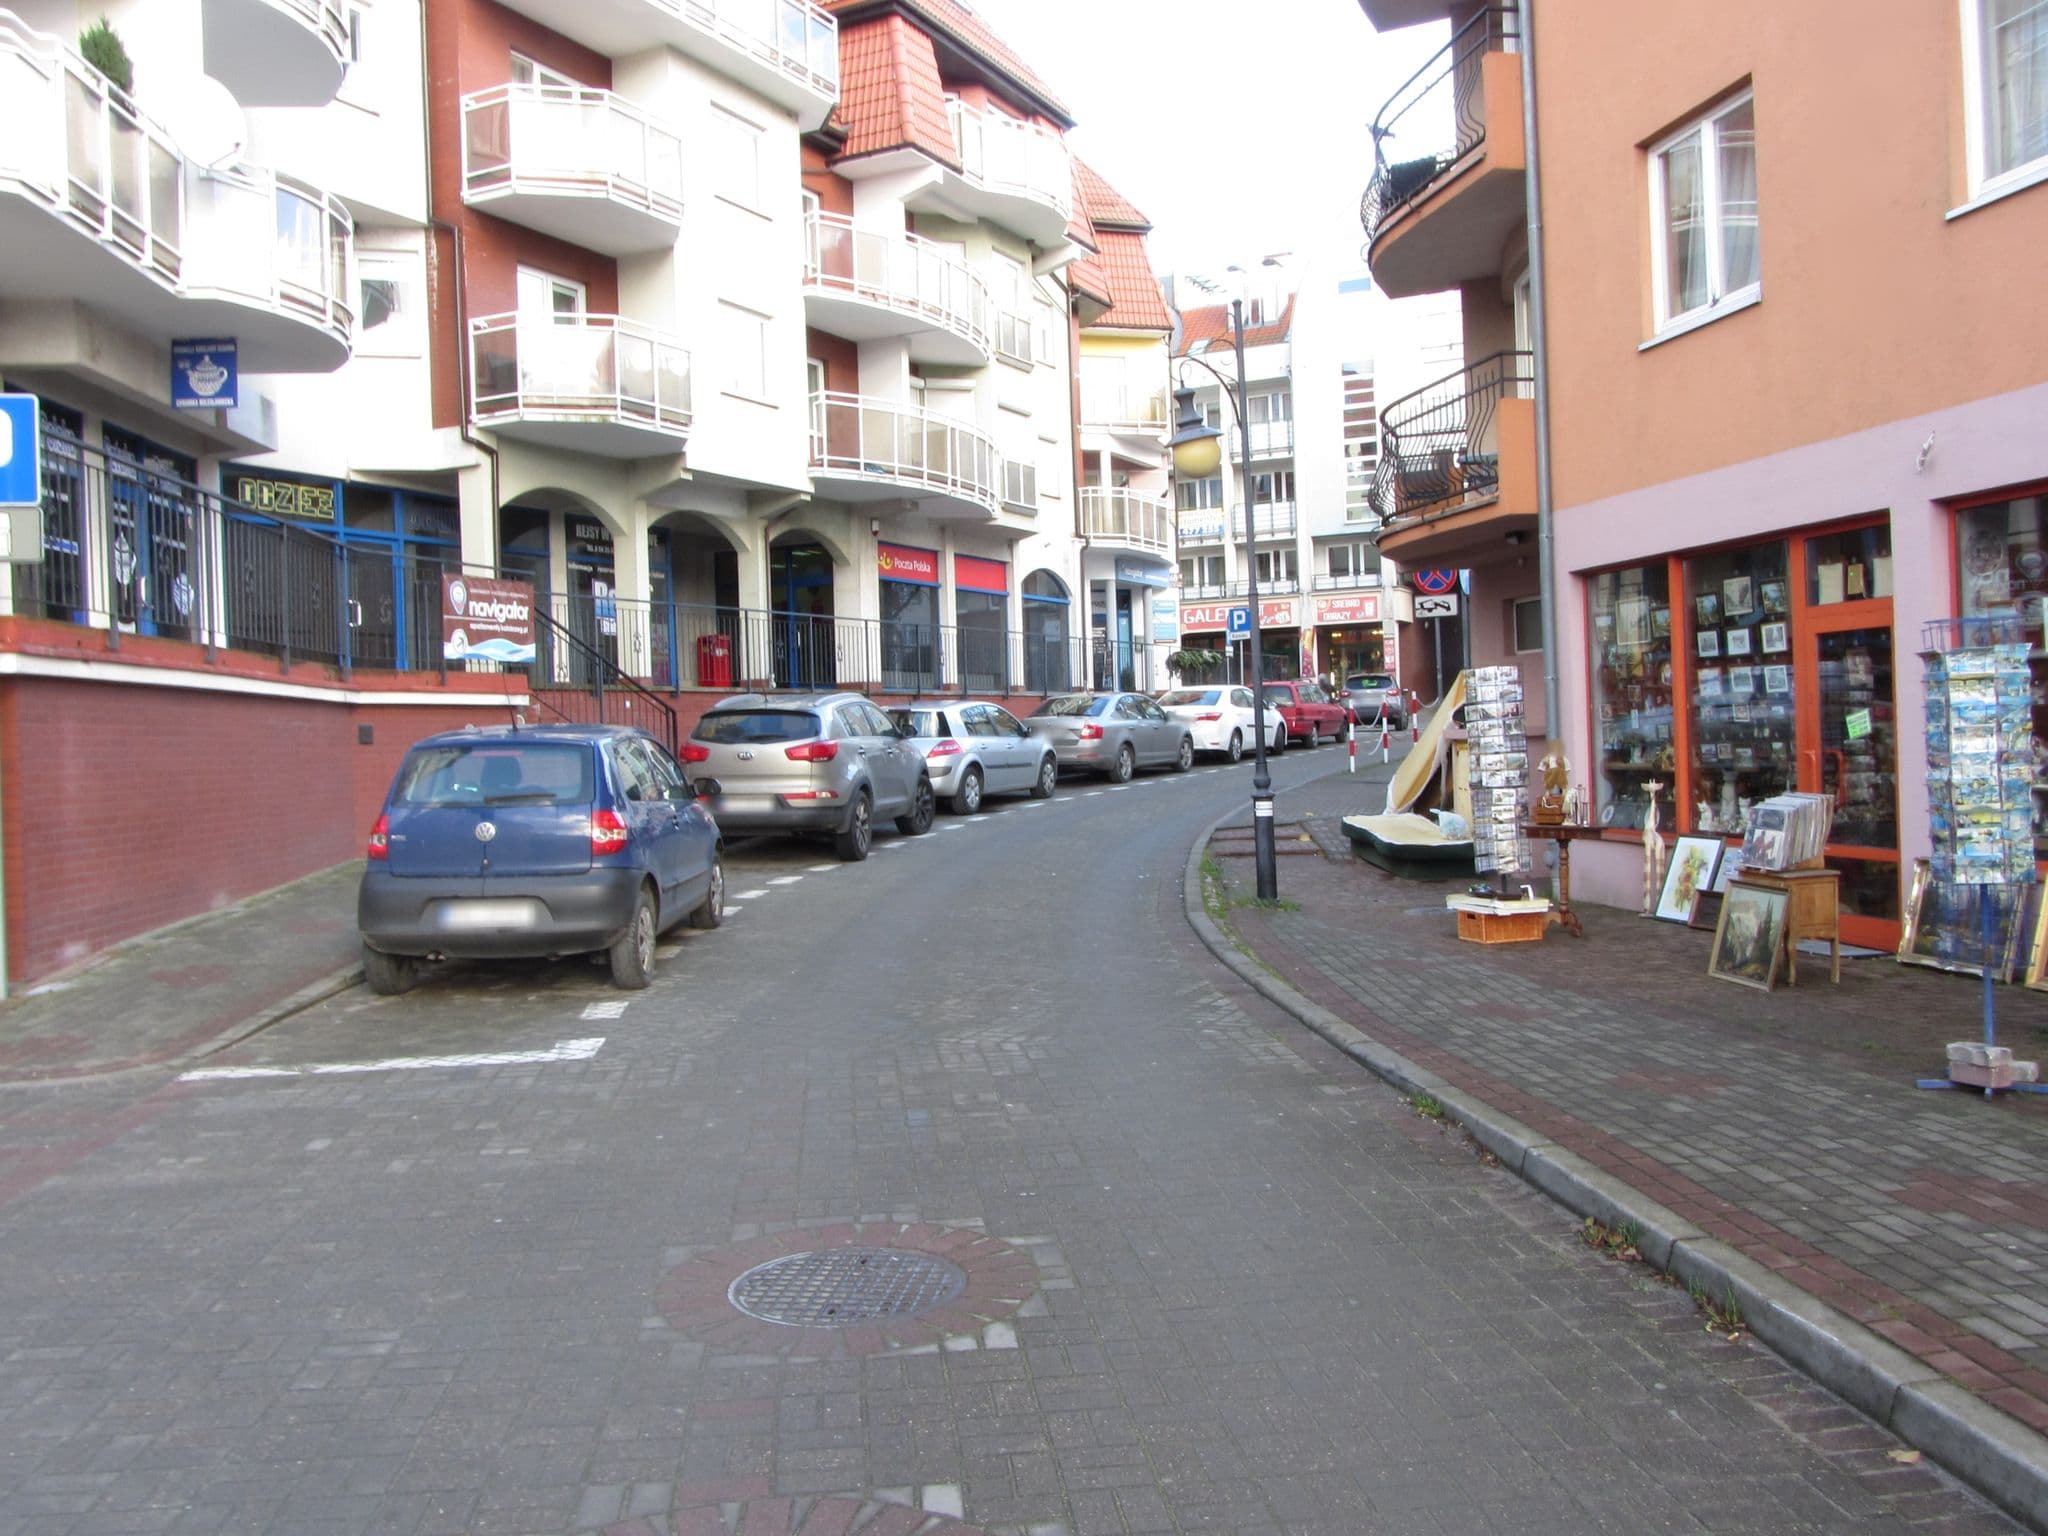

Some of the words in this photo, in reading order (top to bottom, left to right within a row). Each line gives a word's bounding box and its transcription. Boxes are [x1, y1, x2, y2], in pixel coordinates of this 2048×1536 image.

[894, 557, 913, 571] Poczta
[914, 560, 931, 573] Polska
[468, 598, 529, 623] navigator
[1233, 610, 1246, 630] P
